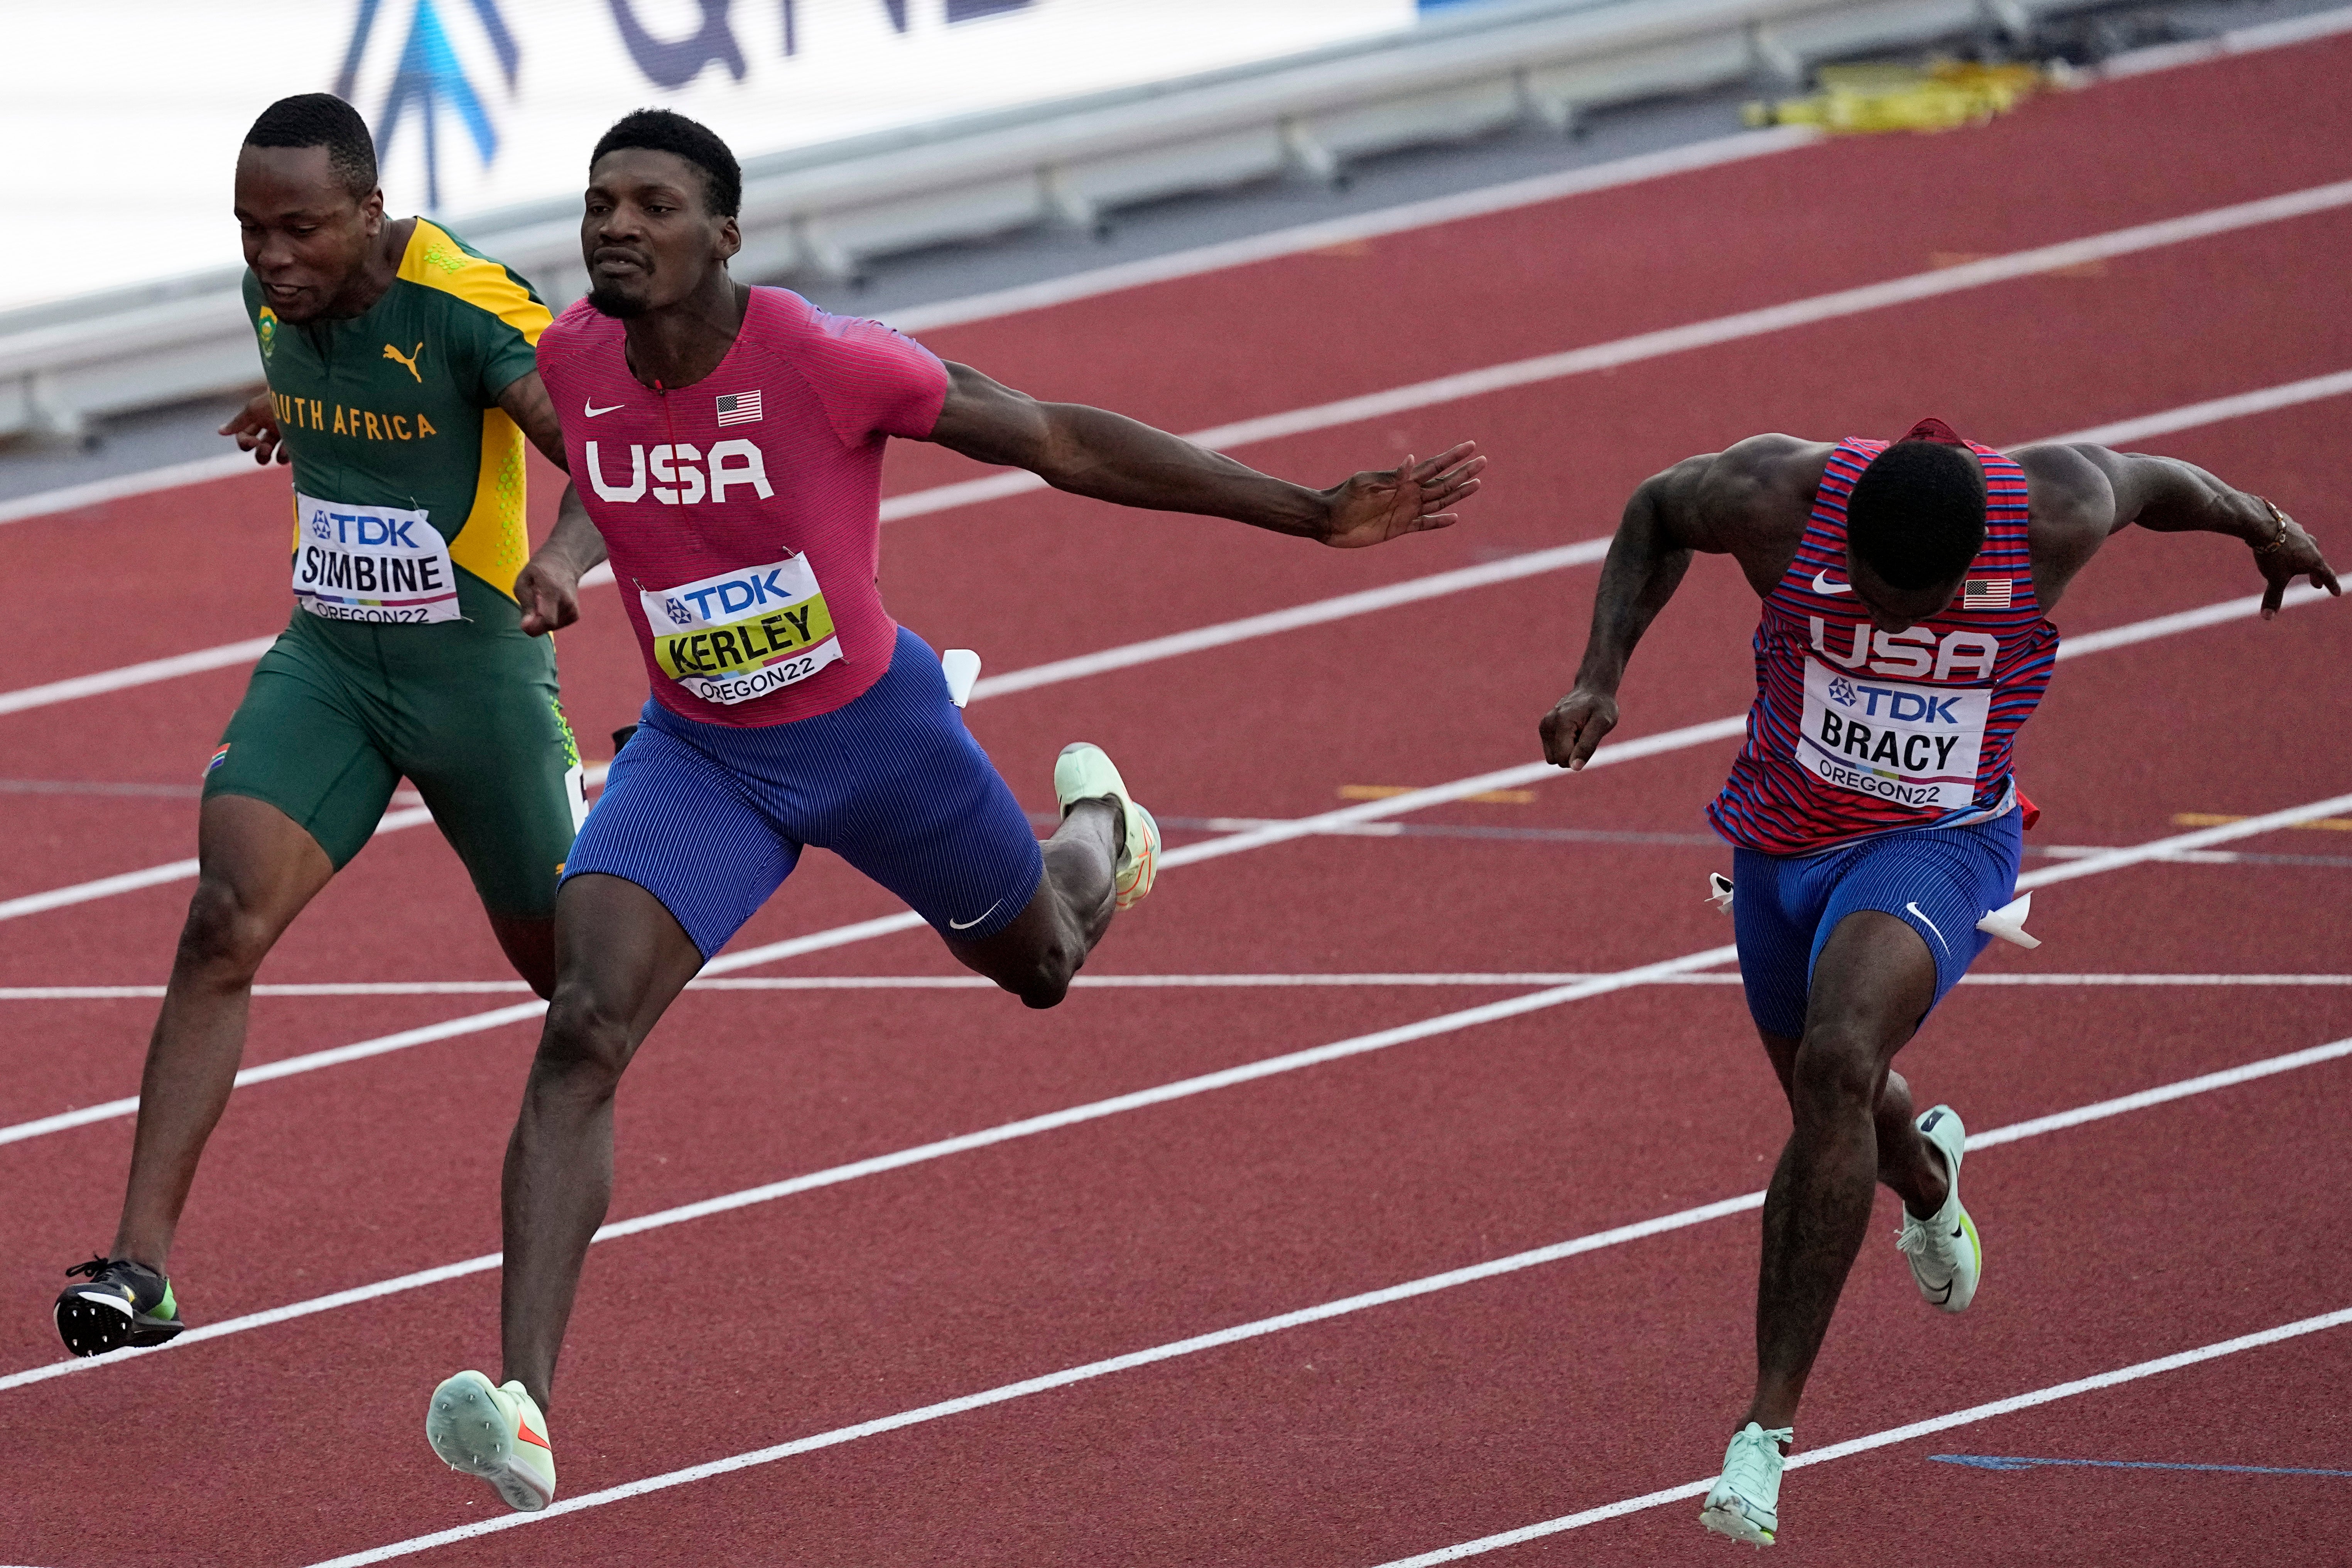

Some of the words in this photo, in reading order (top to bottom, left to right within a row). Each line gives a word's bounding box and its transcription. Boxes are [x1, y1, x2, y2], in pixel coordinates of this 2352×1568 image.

[271, 391, 324, 430] OUTH
[333, 404, 437, 440] AFRICA
[586, 439, 774, 504] USA
[330, 513, 419, 548] TDK
[302, 545, 443, 592] SIMBINE
[317, 603, 429, 623] OREGON22
[684, 568, 792, 620] TDK
[670, 605, 811, 673] KERLEY
[1810, 615, 1999, 680] USA
[700, 658, 815, 700] OREGON22
[1856, 685, 1962, 724] TDK
[1821, 708, 1959, 771] BRACY
[1820, 760, 1940, 804] OREGON22
